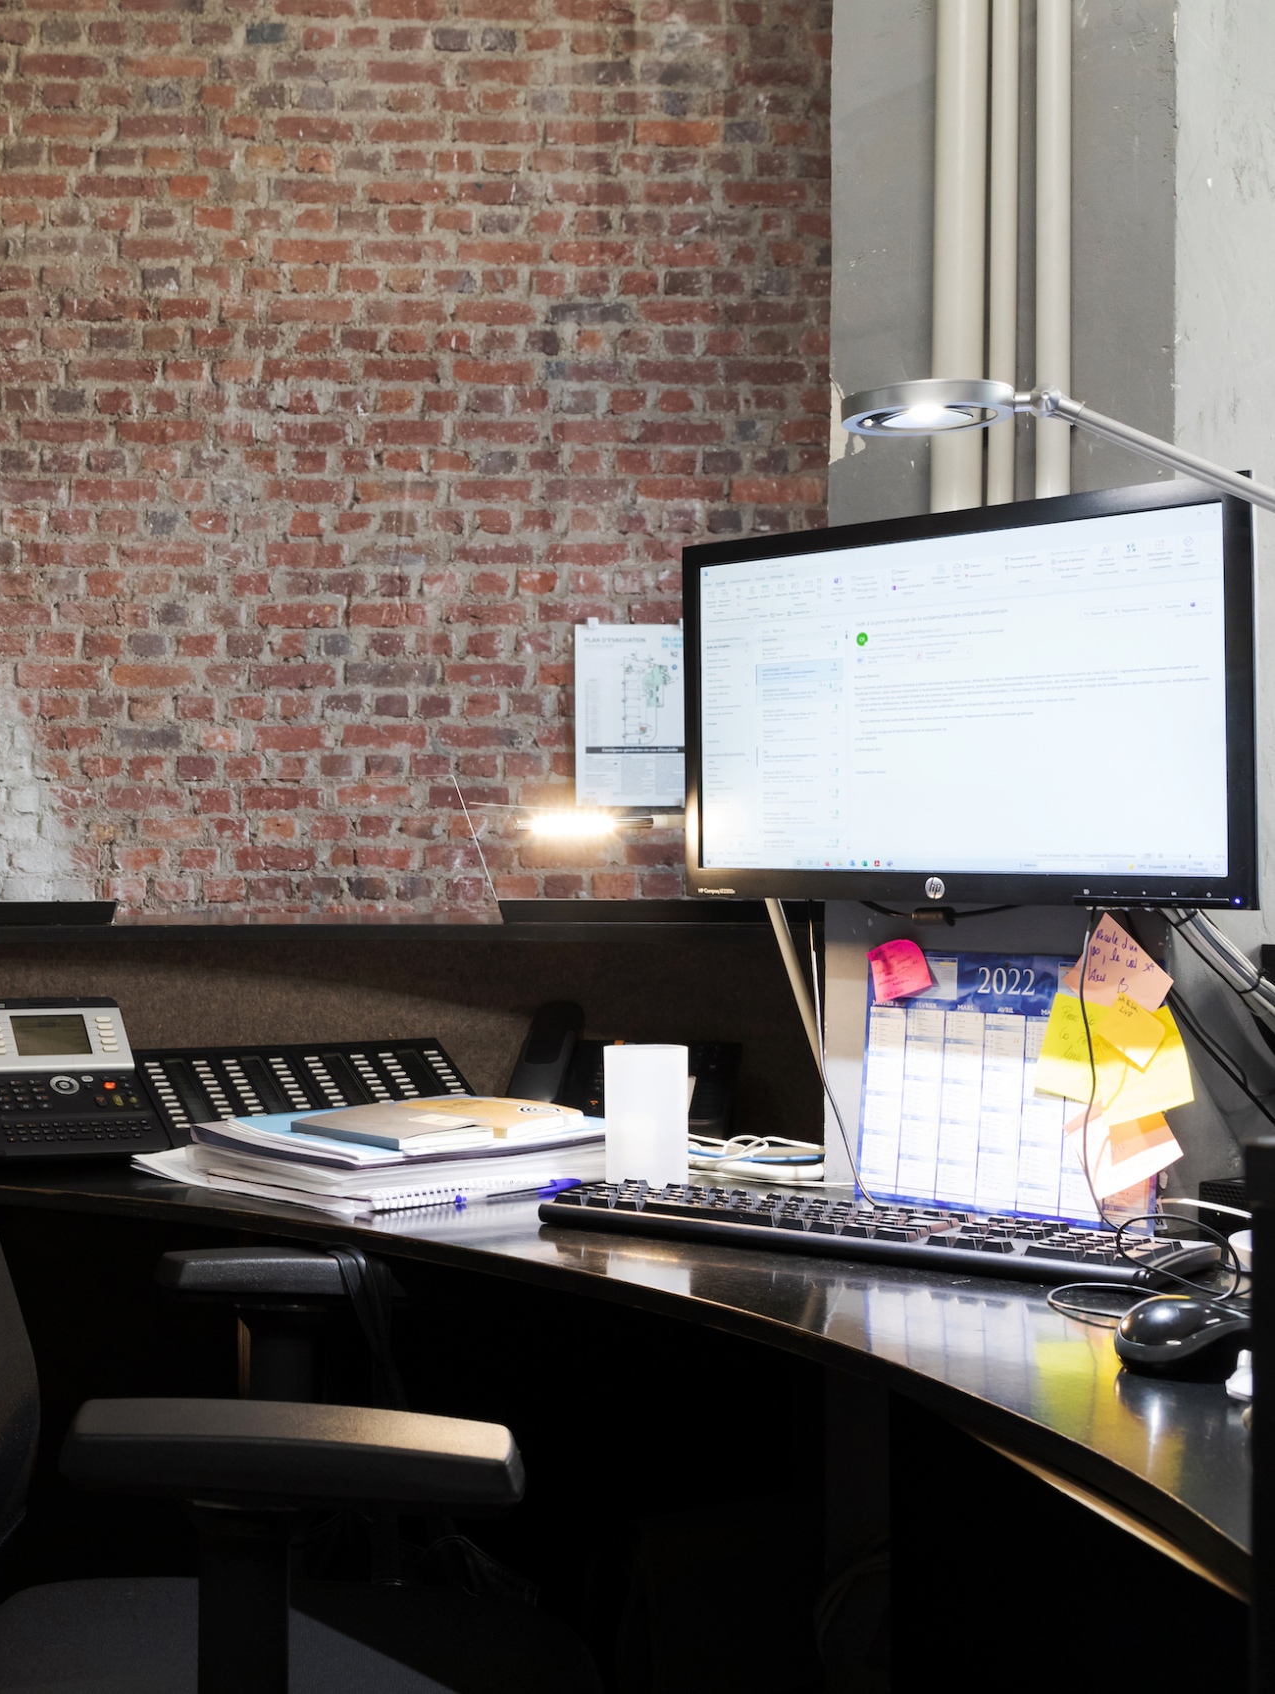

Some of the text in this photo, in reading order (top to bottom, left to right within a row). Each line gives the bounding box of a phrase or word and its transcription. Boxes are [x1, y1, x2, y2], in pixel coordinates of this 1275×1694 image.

[927, 877, 943, 898] hp
[976, 966, 1037, 996] 2022
[957, 1004, 974, 1012] MARS
